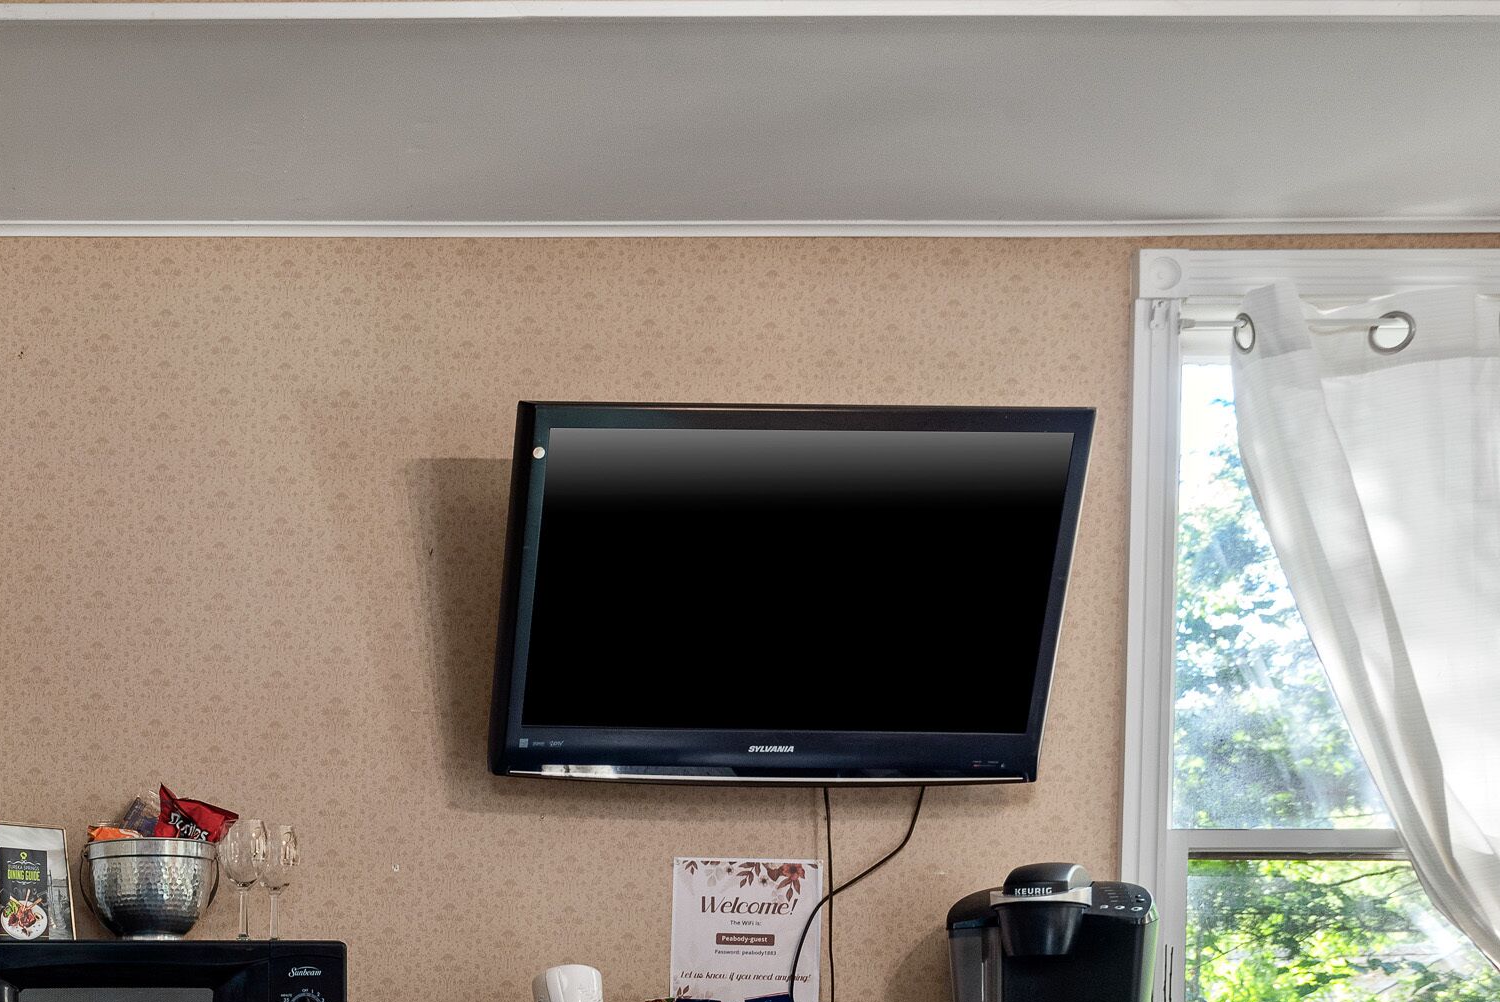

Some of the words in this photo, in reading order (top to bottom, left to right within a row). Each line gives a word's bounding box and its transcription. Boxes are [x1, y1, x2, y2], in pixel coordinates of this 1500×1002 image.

[748, 745, 795, 753] SYLVANIA
[7, 869, 24, 880] DINING
[25, 870, 41, 881] GUIDE
[1014, 887, 1052, 895] KEURIG
[701, 896, 798, 915] Welcome!
[721, 935, 768, 944] Peabody-guest
[288, 966, 322, 977] Sunbeam
[680, 971, 693, 979] Let
[736, 974, 751, 982] you
[753, 973, 773, 981] need
